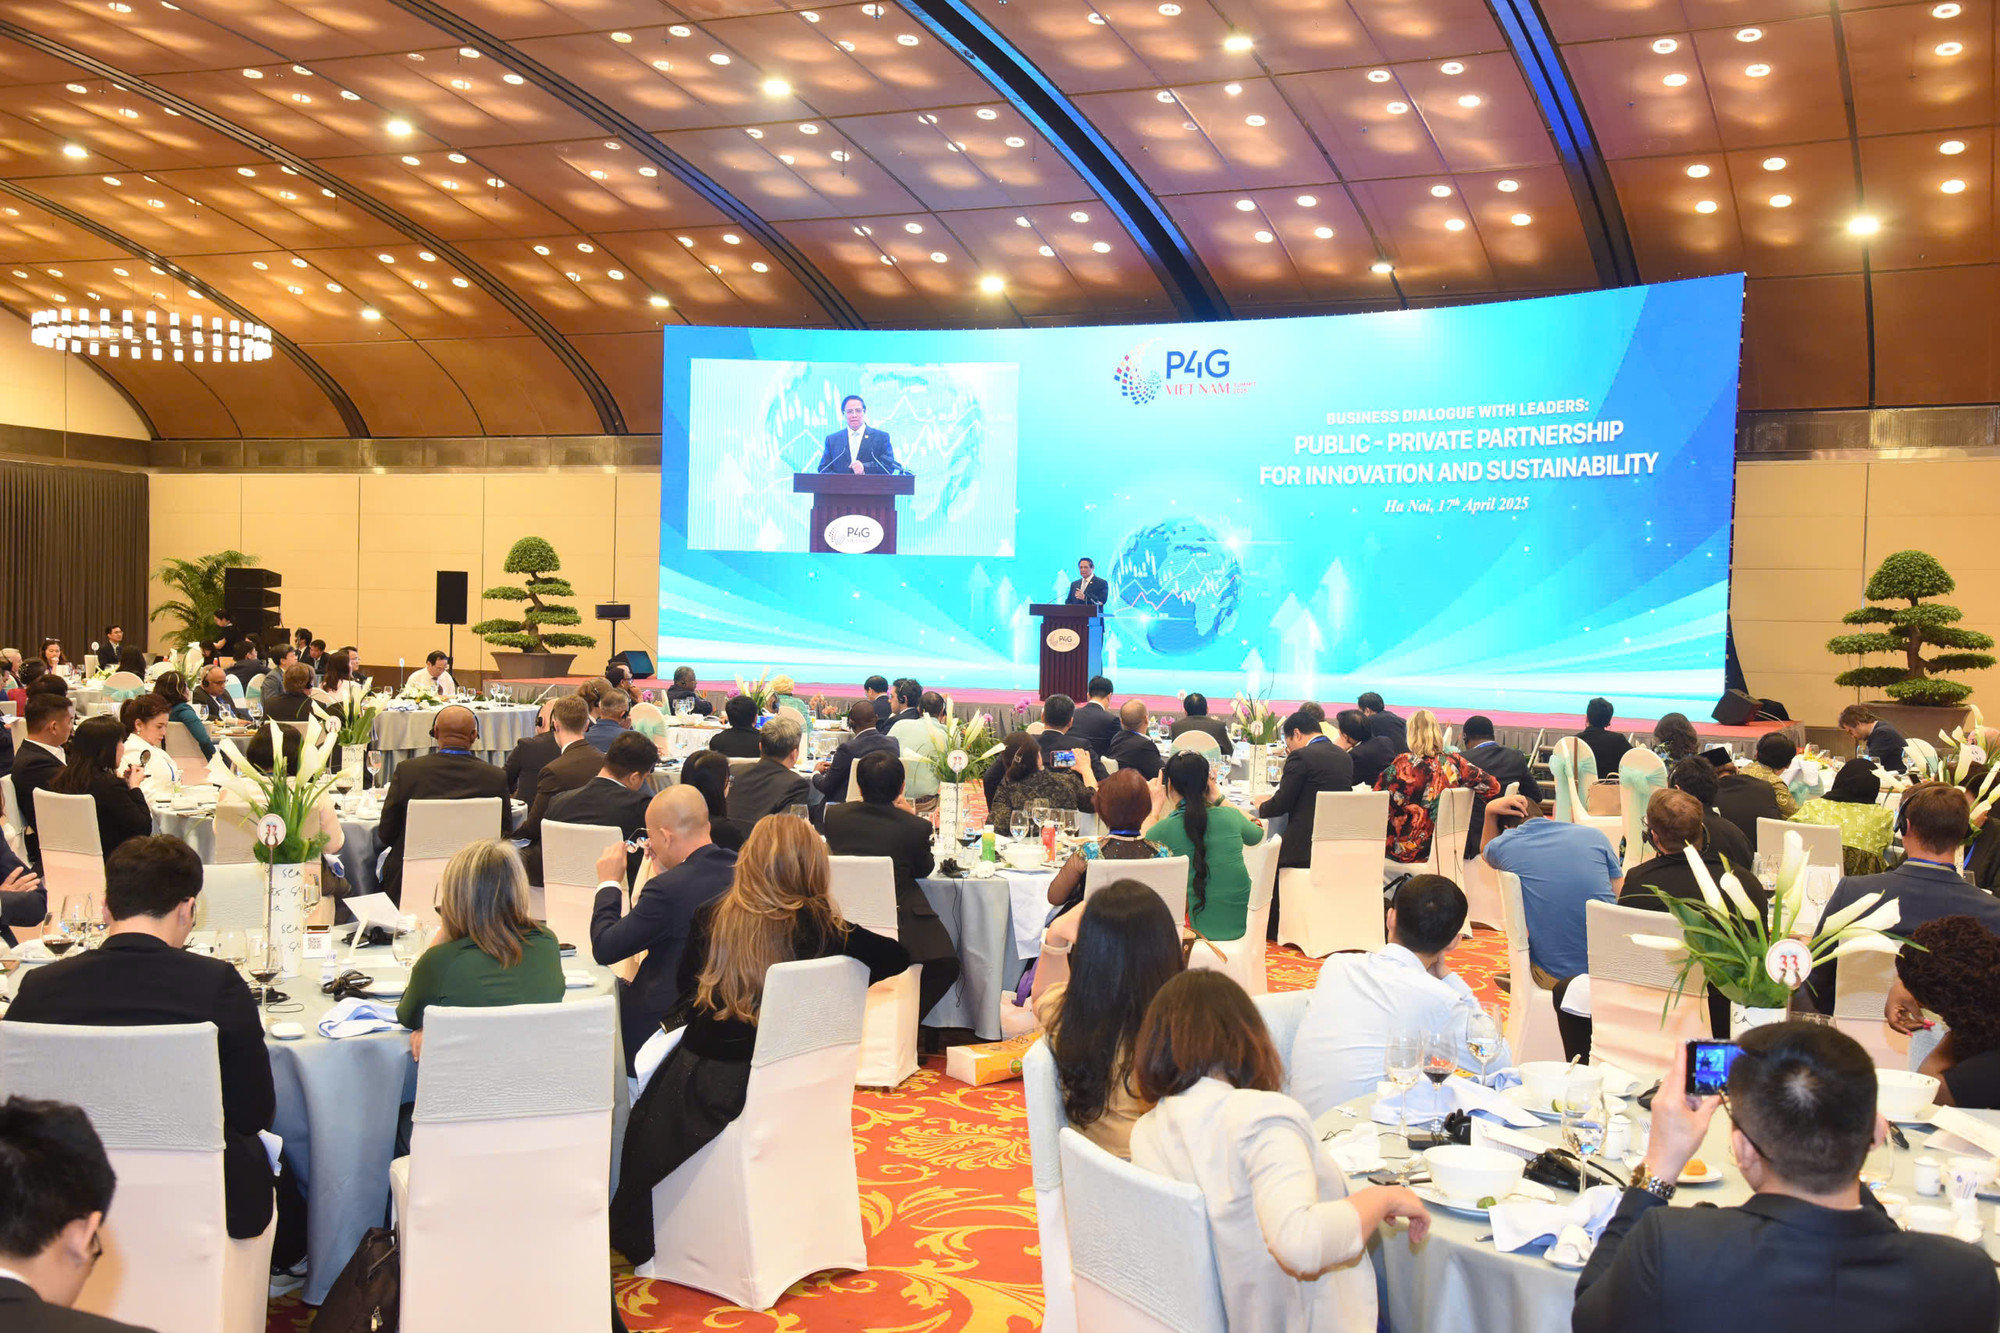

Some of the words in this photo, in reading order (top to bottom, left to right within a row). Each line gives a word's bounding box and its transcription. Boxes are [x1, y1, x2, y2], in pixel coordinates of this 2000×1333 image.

[1166, 349, 1230, 379] P4G
[1165, 383, 1194, 395] VIET
[1199, 382, 1230, 395] NAM
[1326, 410, 1399, 425] BUSINESS
[1402, 406, 1475, 422] DIALOGUE
[1478, 403, 1516, 419] WITH
[1519, 399, 1589, 416] LEADERS:
[1294, 434, 1371, 454] PUBLIC
[1387, 429, 1474, 453] PRIVATE
[1477, 420, 1624, 449] PARTNERSHIP
[1259, 466, 1302, 486] FOR
[1305, 463, 1434, 485] INNOVATION
[1437, 461, 1483, 482] AND
[1486, 452, 1660, 481] SUSTAINABILITY
[1384, 499, 1405, 513] Ha
[1406, 499, 1435, 515] Noi,
[1437, 498, 1461, 513] 17th
[1461, 497, 1496, 516] April
[1496, 496, 1530, 511] 2025
[847, 527, 870, 538] P4G
